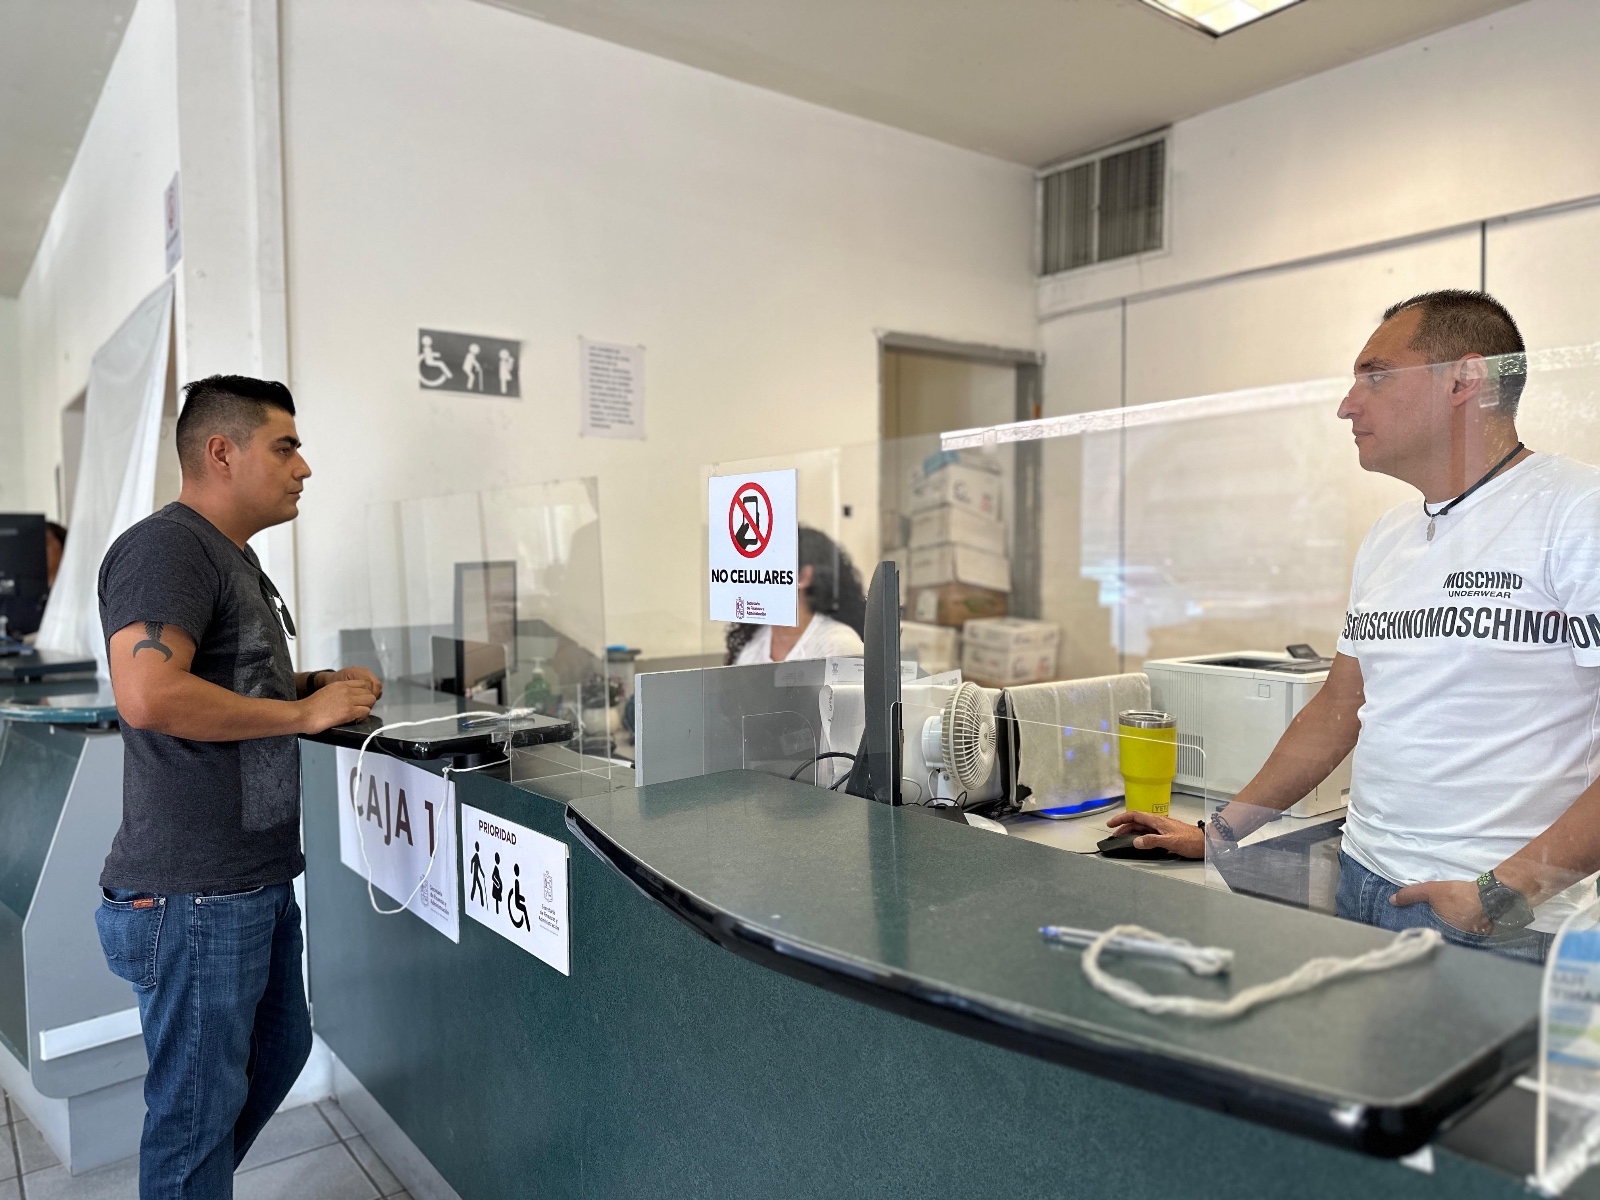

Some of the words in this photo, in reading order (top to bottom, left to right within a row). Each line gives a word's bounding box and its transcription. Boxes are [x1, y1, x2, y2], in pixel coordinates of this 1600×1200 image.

[711, 569, 729, 583] NO
[730, 569, 794, 585] CELULARES
[1443, 571, 1523, 589] MOSCHINO
[350, 767, 413, 846] CAJA
[425, 800, 435, 859] 1
[479, 820, 517, 845] PRIORIDAD
